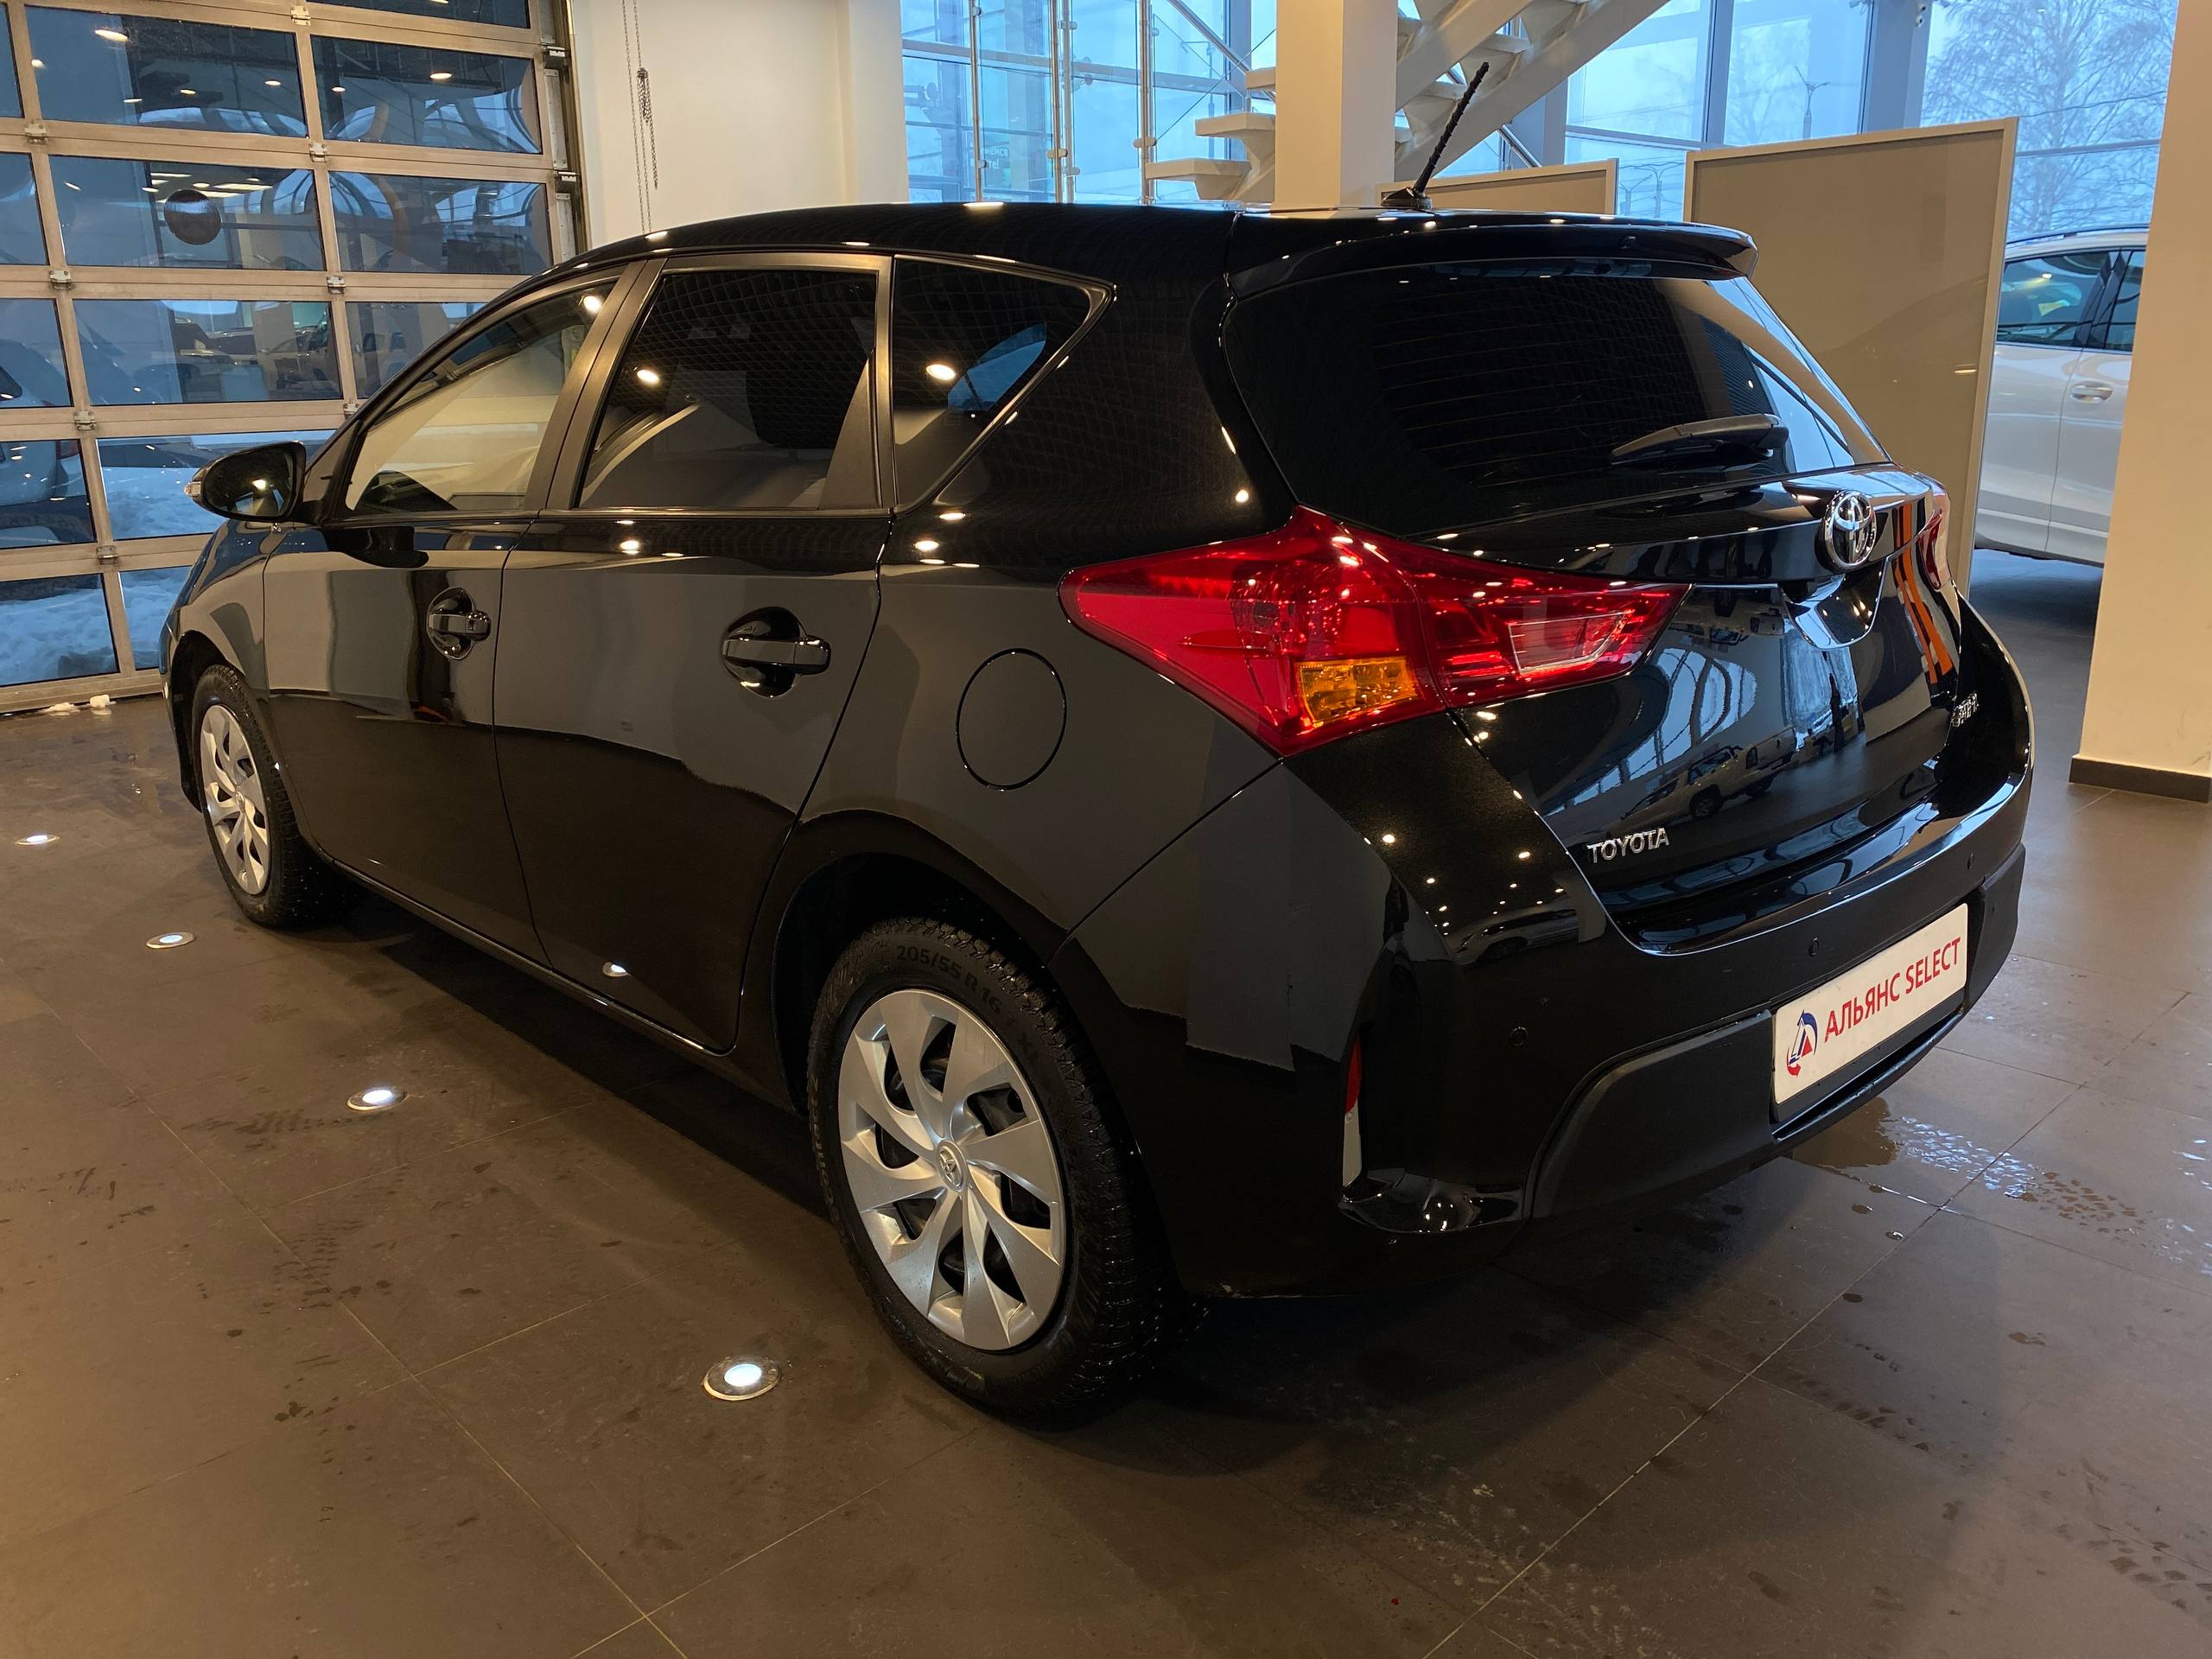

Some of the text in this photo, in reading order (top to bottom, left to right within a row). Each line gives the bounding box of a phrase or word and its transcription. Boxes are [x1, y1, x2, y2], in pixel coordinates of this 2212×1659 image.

[1586, 827, 1670, 864] TOYOTA
[896, 944, 963, 980] 205/55
[1824, 937, 1961, 1044] АЛЬЯНС SELECT
